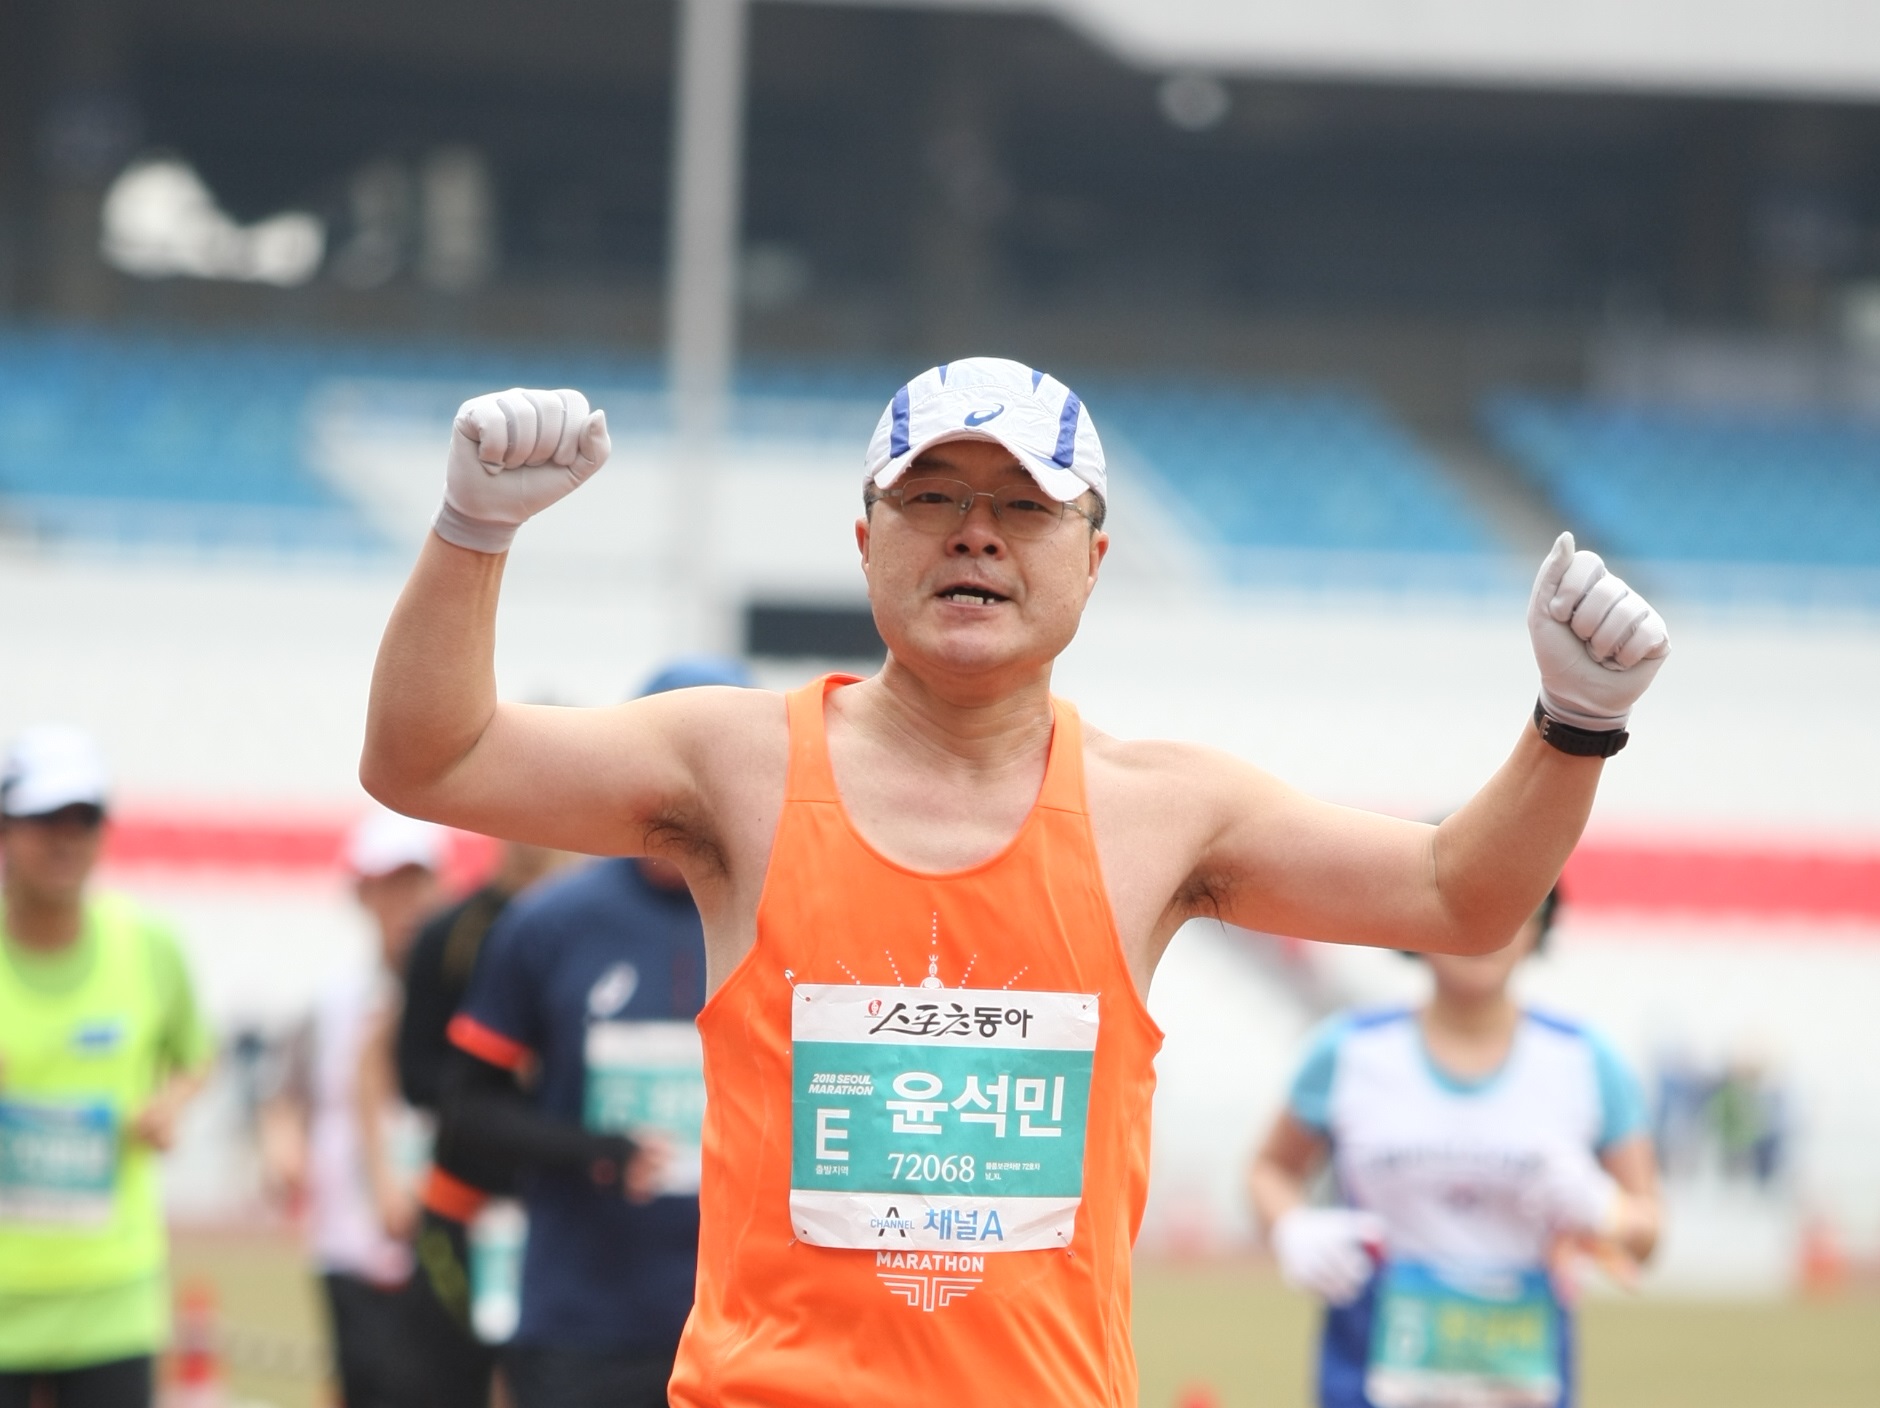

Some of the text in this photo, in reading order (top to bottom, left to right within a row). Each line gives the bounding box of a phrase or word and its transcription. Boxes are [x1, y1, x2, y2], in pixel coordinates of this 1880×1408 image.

[868, 1002, 1034, 1038] 스포츠동아
[808, 1084, 873, 1095] MARATHON
[812, 1073, 872, 1084] 2018 SEOUL
[886, 1071, 1065, 1138] 윤석민
[816, 1108, 850, 1160] E
[887, 1153, 975, 1182] 72068
[870, 1219, 915, 1230] CHANNEL
[923, 1208, 1004, 1241] 채널A
[876, 1251, 984, 1273] MARATHON
